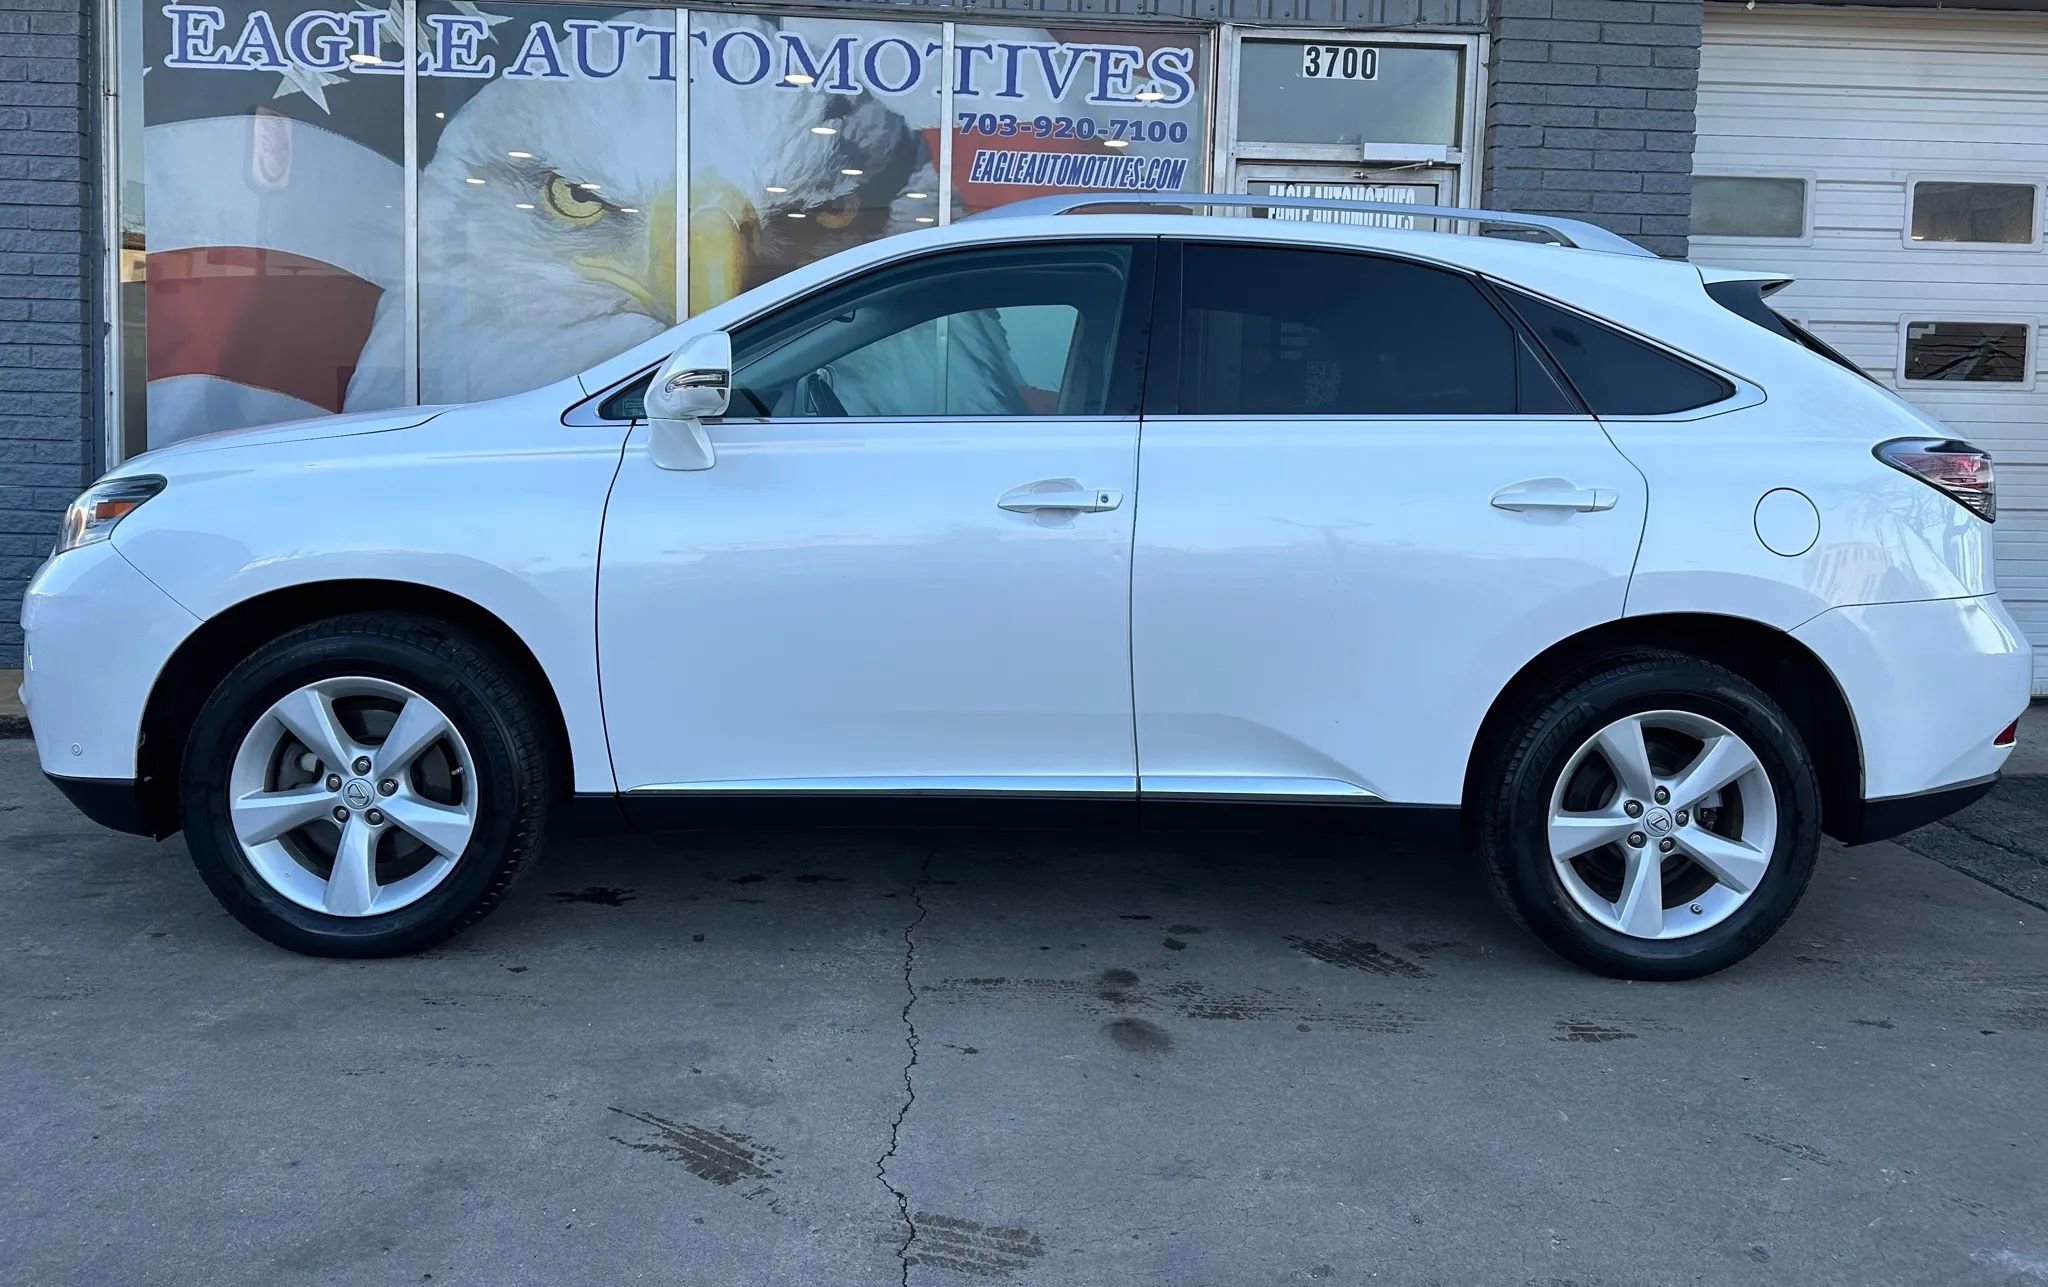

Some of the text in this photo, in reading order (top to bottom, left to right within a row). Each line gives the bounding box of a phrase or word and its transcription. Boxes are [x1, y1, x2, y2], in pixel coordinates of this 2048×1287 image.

[163, 5, 1195, 107] EAGLE AUTOMOTIVES
[1304, 46, 1377, 80] 3700
[958, 112, 1189, 143] 703-920-7100
[969, 149, 1189, 191] EAGLEAUTOMOTIVES.COM
